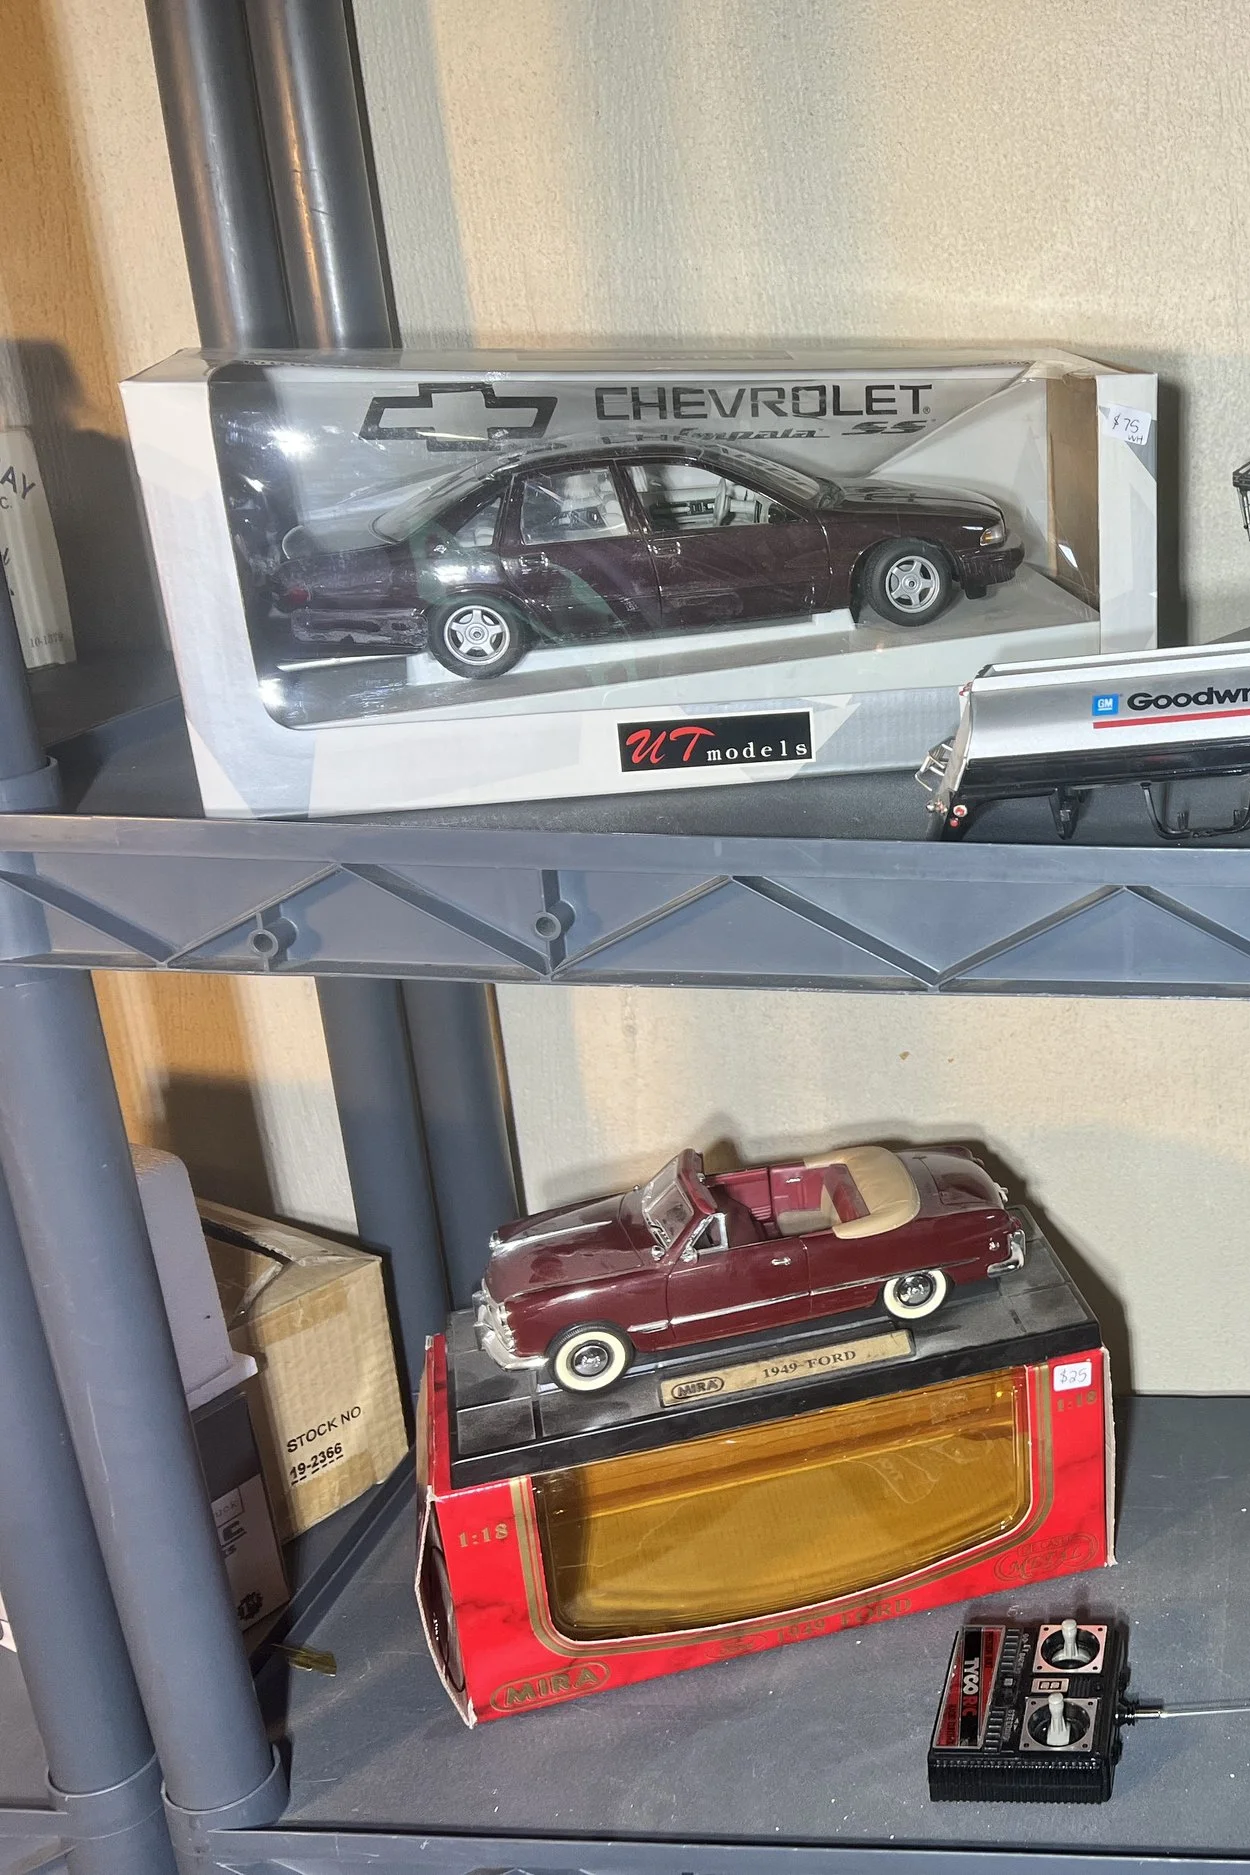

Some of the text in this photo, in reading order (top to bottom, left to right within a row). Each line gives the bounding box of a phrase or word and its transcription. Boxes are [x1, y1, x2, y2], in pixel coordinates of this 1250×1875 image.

[595, 383, 932, 421] CHEVROLET
[841, 420, 927, 436] SS
[626, 726, 809, 765] UT models
[677, 1350, 857, 1397] MIRA 1949 FORD
[1058, 1366, 1088, 1384] $25
[286, 1405, 362, 1453] STOCK NO
[289, 1442, 343, 1484] 19-2366
[458, 1522, 509, 1549] 1:18
[504, 1666, 599, 1708] MIRA
[962, 1656, 980, 1696] TYCO
